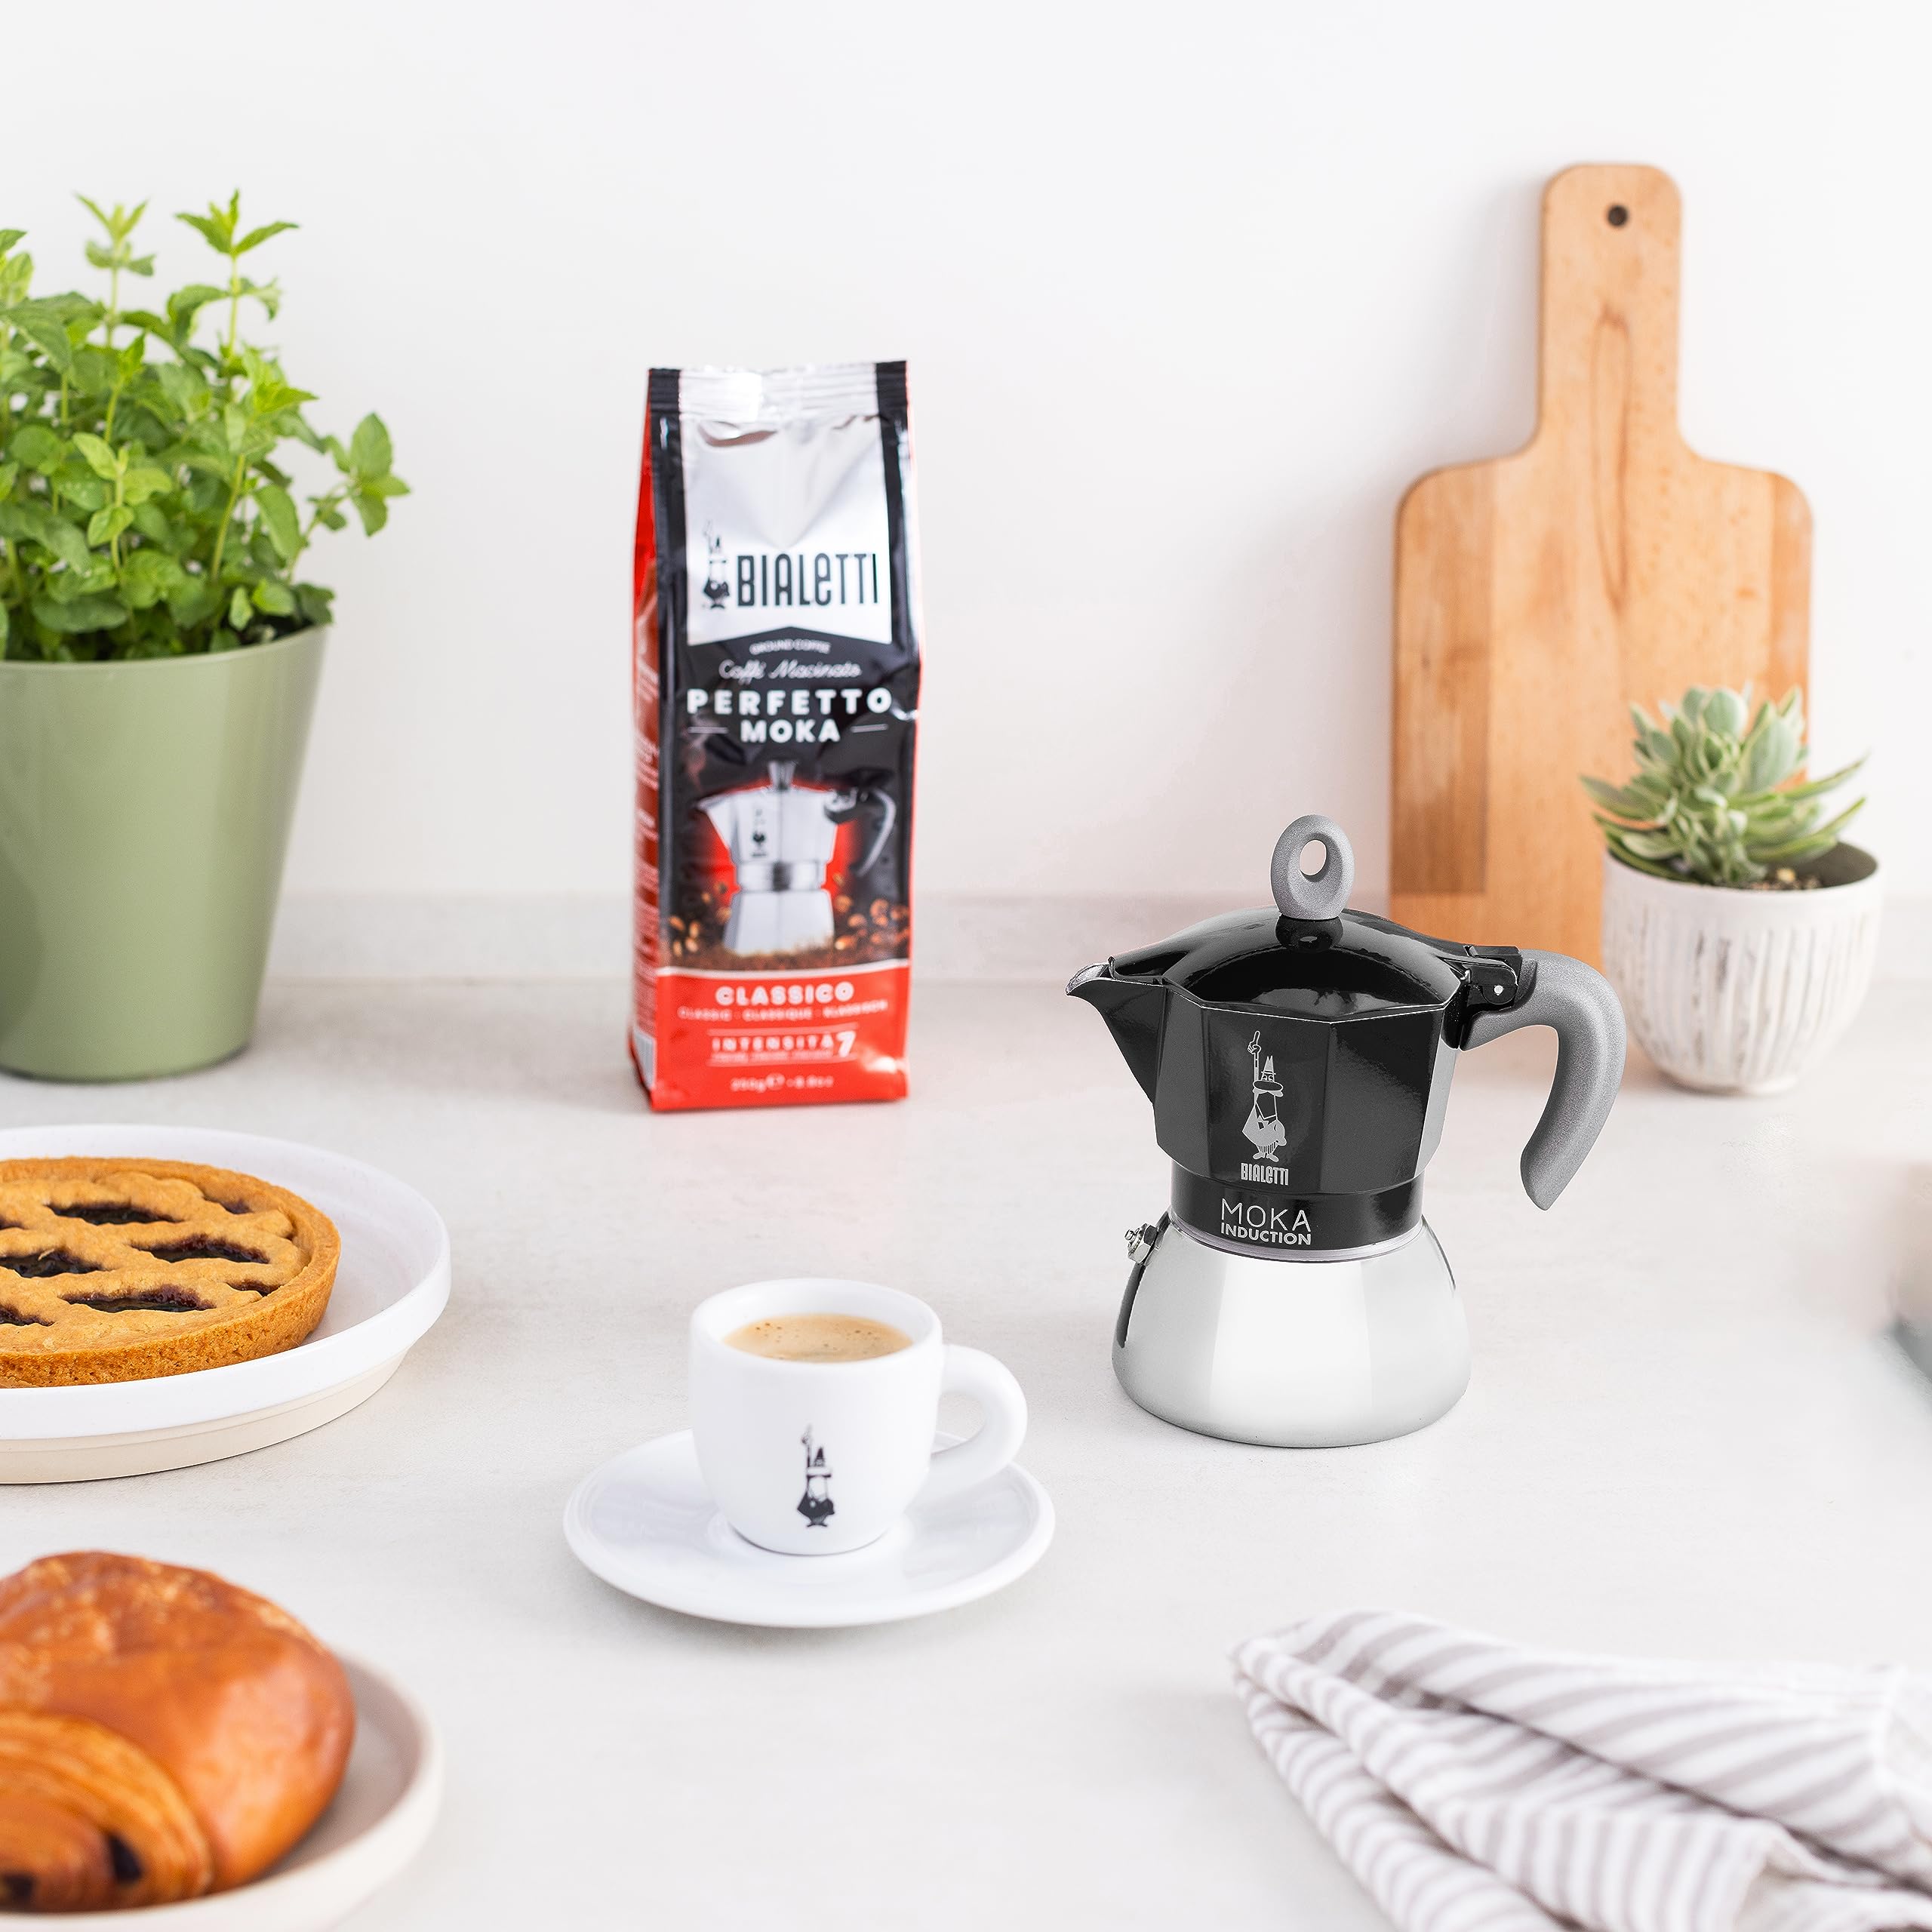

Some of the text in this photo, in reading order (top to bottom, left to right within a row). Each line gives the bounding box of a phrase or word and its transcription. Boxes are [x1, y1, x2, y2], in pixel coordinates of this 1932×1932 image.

[686, 688, 892, 716] PERFETTO
[740, 718, 841, 743] MOKA
[715, 981, 854, 1007] CLASSICO
[836, 1030, 857, 1058] 7
[1221, 1198, 1312, 1232] MOKA
[1220, 1222, 1312, 1245] INDUCTION
